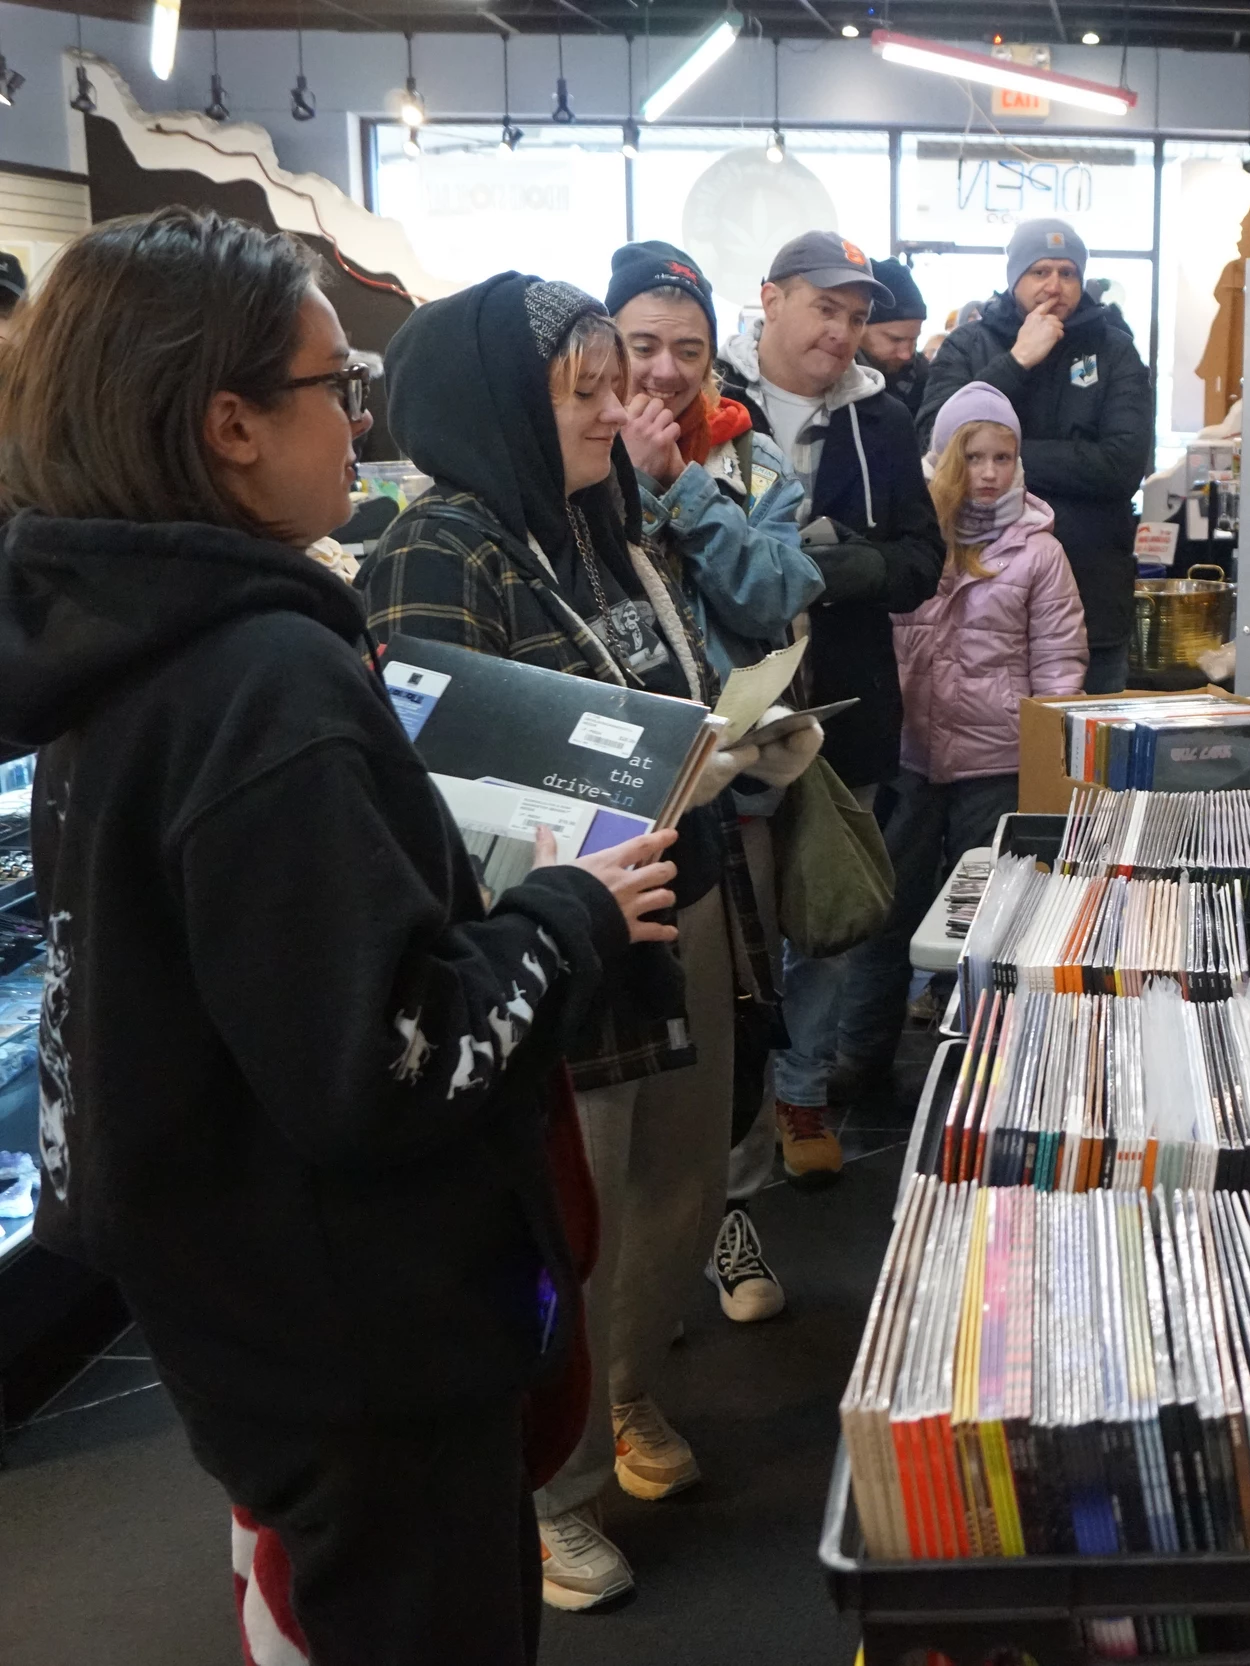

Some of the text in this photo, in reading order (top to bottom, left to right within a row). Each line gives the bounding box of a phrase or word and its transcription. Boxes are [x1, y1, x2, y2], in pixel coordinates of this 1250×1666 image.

[629, 755, 653, 770] at
[610, 769, 644, 788] the
[542, 773, 635, 807] drive-in
